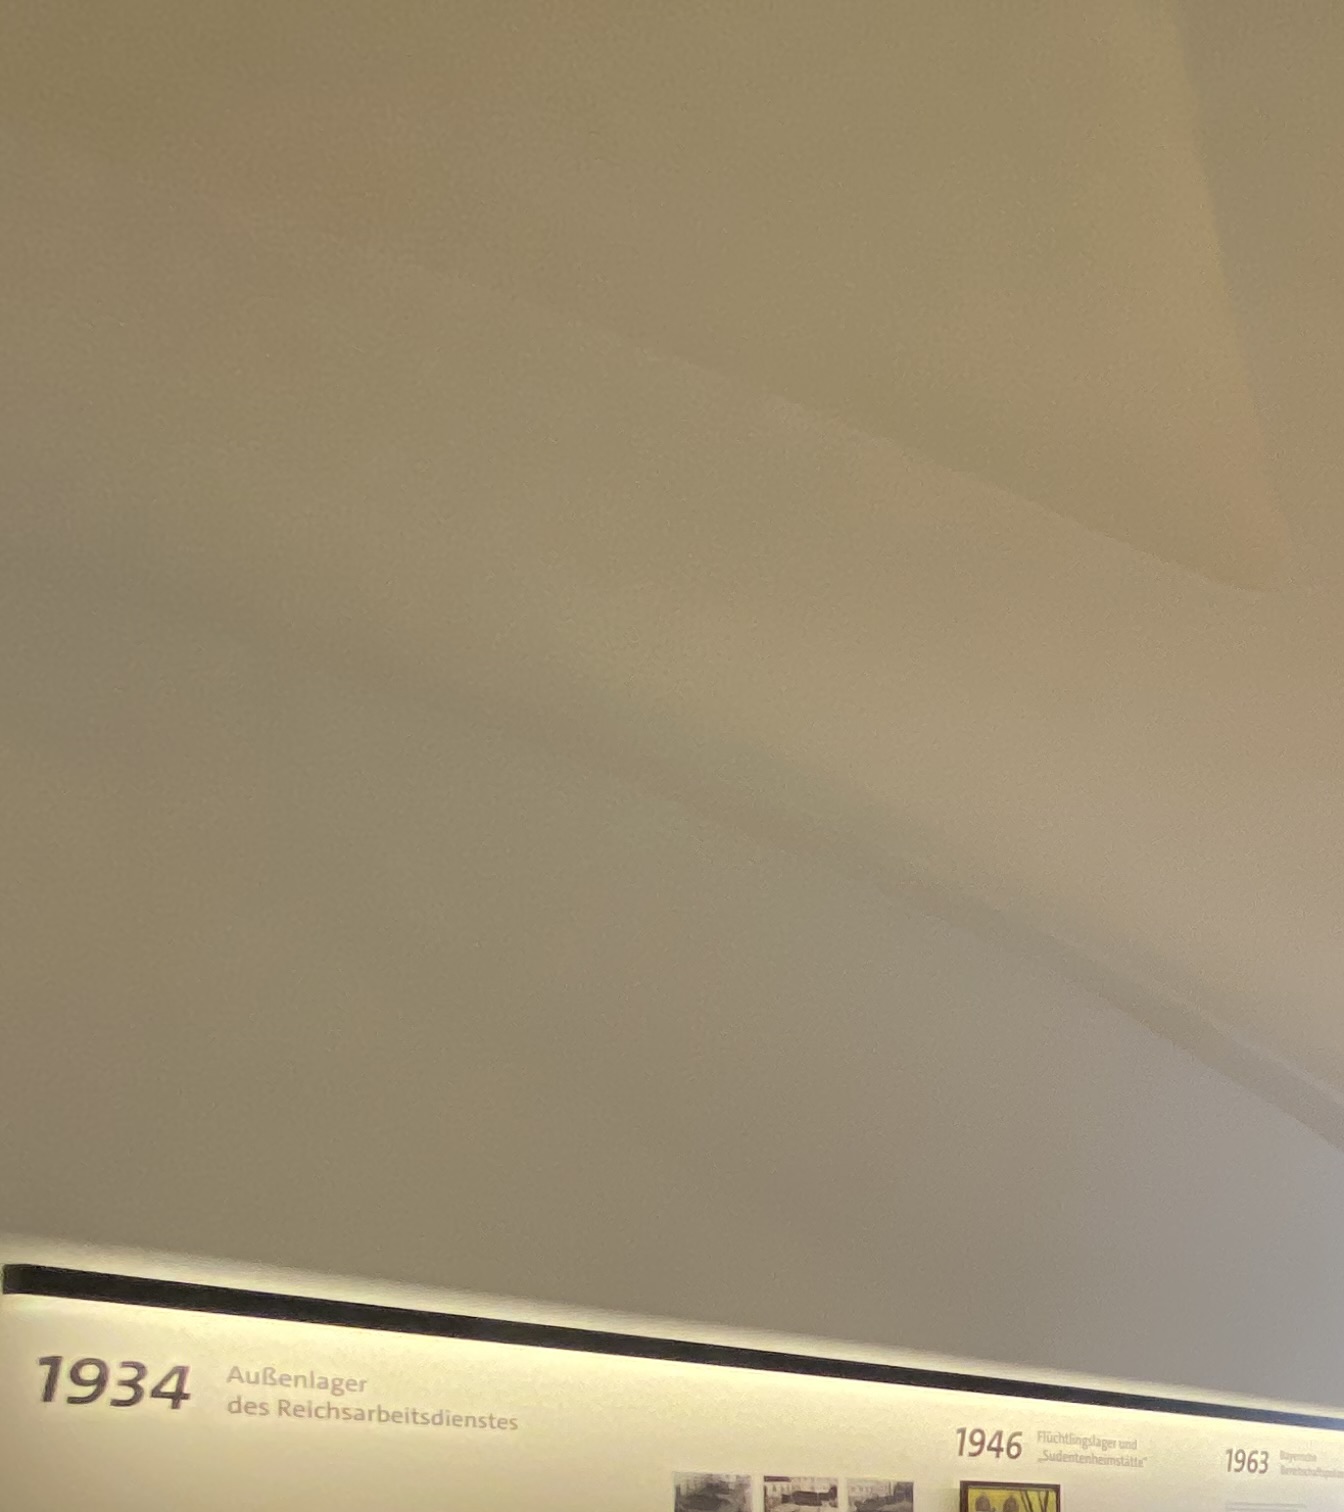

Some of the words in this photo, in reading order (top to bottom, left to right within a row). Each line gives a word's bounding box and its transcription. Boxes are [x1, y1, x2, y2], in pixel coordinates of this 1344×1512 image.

[37, 1354, 192, 1410] 1934
[225, 1365, 368, 1394] Außenlager
[226, 1396, 270, 1417] des
[277, 1398, 519, 1431] Reichsarbeitsdienstes
[955, 1426, 1023, 1460] 1946
[1225, 1448, 1270, 1475] 1963
